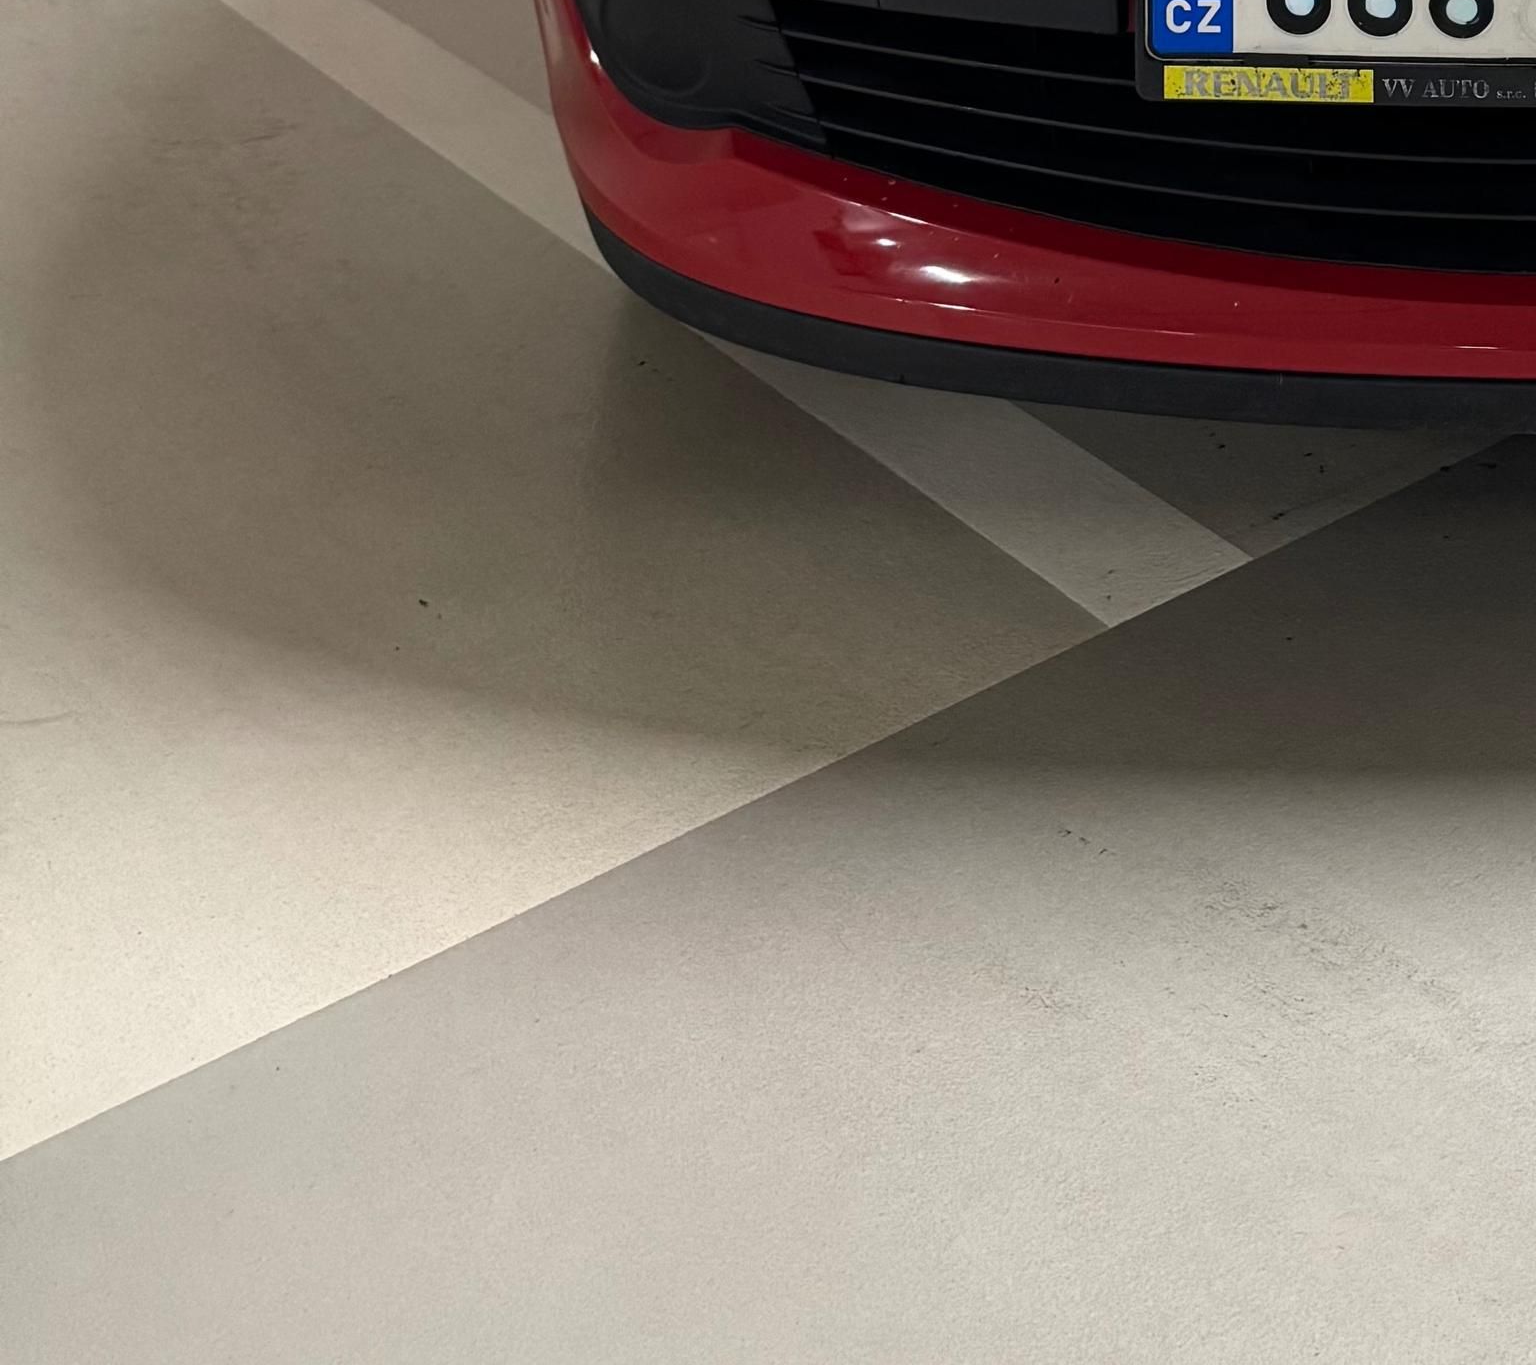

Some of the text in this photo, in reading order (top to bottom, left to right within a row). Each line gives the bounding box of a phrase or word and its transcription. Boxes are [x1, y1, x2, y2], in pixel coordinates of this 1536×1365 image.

[1183, 69, 1359, 100] RENAULT
[1382, 78, 1416, 98] VV
[1421, 78, 1491, 99] AUTO
